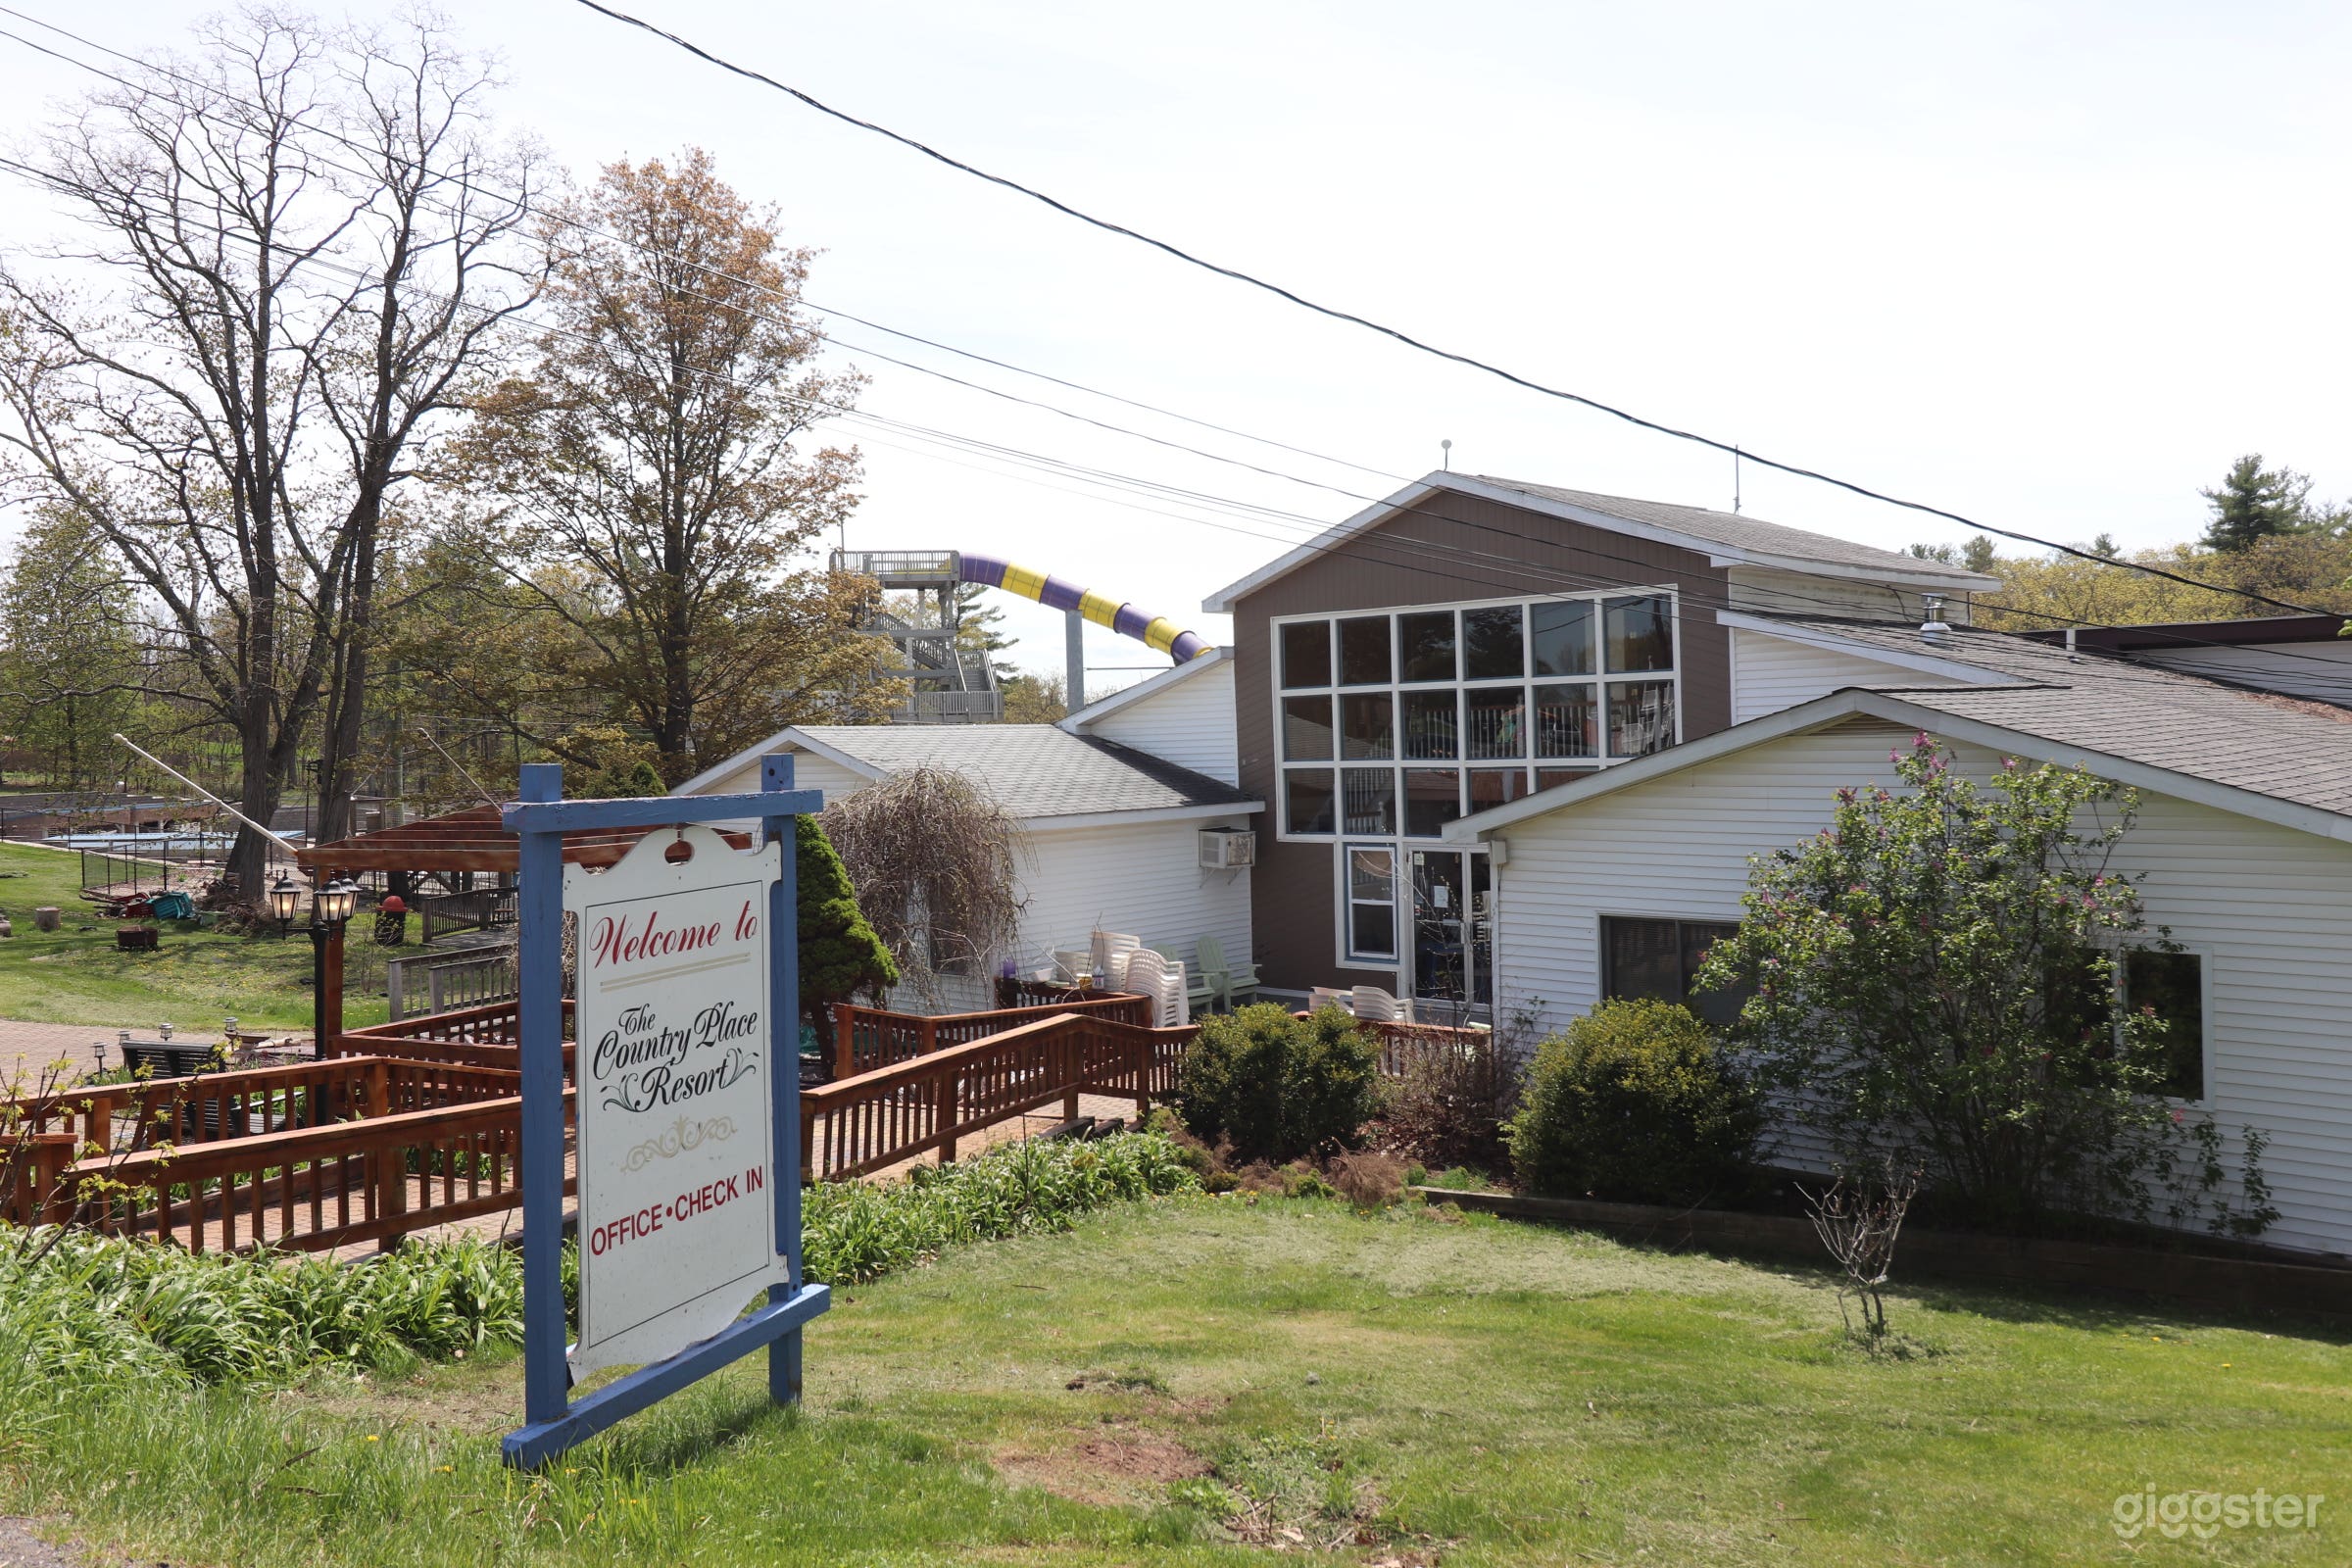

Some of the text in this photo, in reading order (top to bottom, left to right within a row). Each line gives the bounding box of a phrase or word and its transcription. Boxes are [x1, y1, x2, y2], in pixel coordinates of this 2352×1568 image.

[589, 900, 759, 969] Welcome to
[593, 1001, 759, 1080] Country Place
[618, 1003, 656, 1035] The
[634, 1058, 729, 1112] Resort
[747, 1165, 763, 1193] IN
